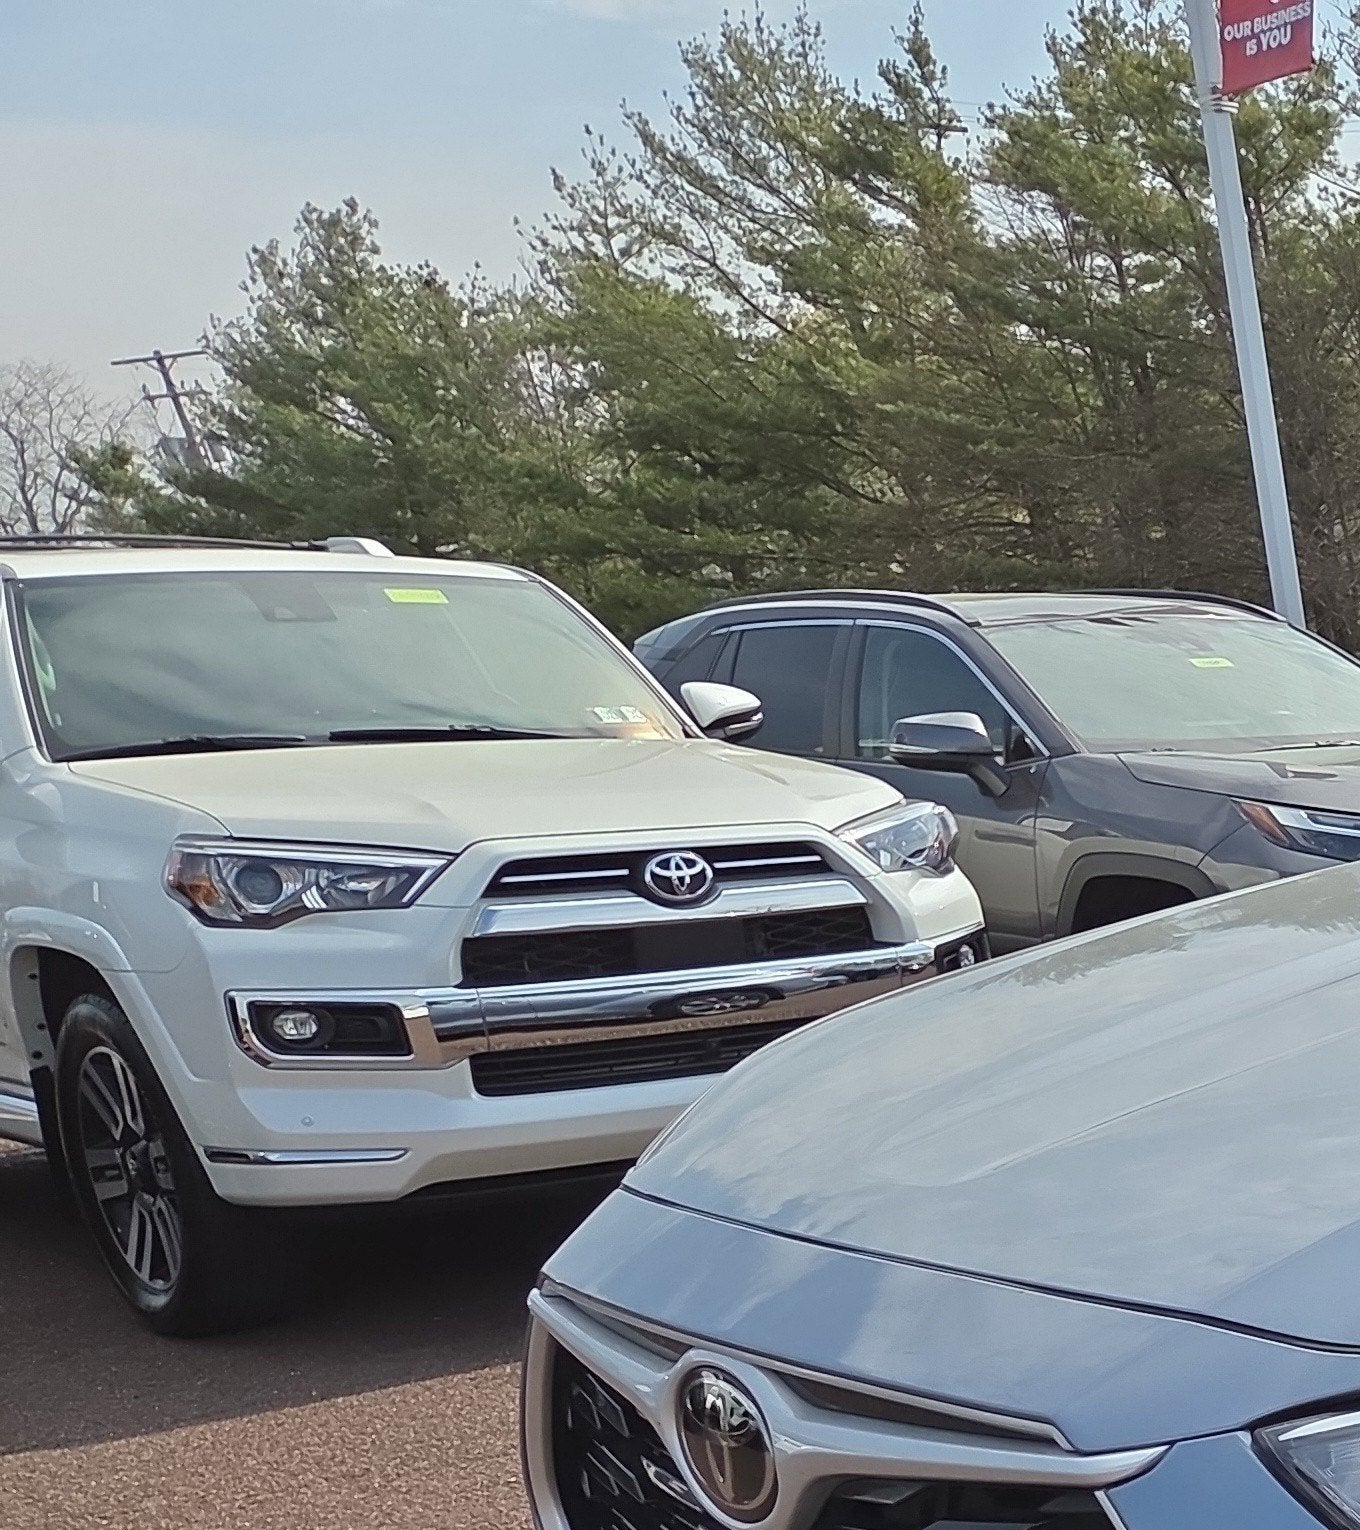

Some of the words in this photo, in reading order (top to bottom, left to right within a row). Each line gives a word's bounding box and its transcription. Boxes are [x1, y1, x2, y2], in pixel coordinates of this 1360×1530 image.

[1223, 20, 1252, 42] OUR
[1253, 2, 1312, 33] BUSINESS
[1245, 40, 1258, 56] IS
[1261, 25, 1292, 51] YOU
